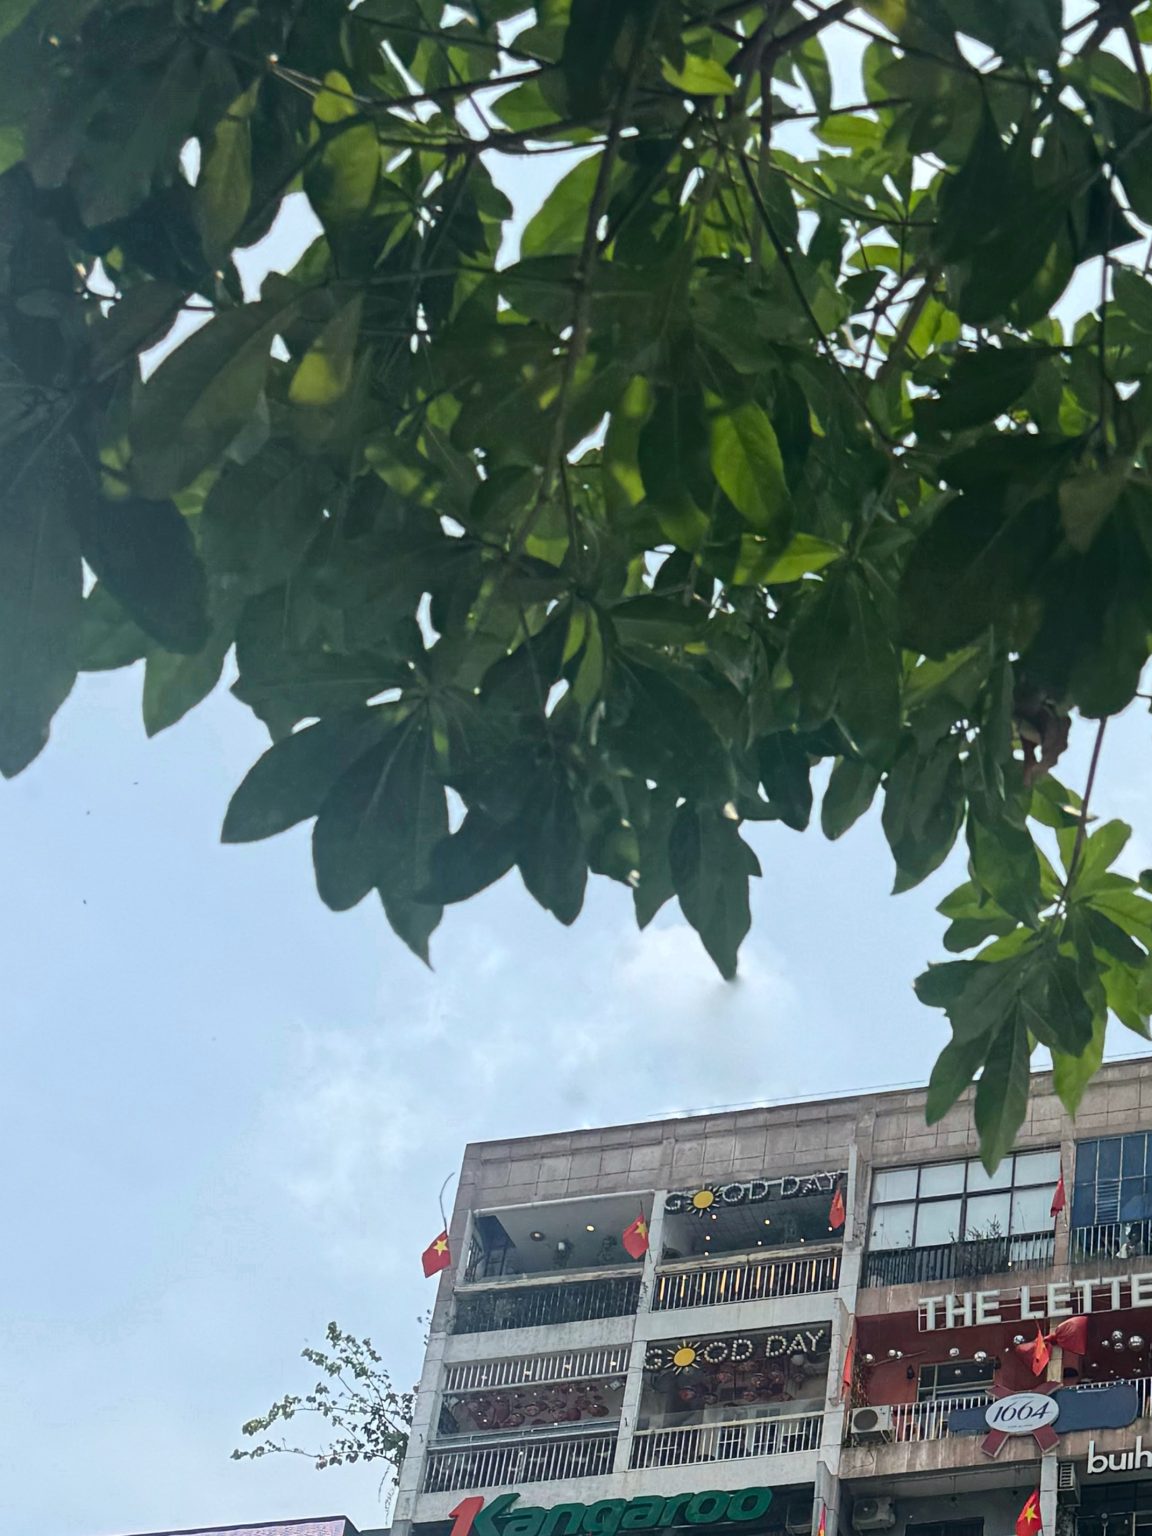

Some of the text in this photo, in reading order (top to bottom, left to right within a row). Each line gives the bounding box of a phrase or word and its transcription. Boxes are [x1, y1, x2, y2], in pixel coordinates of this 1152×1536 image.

[918, 1289, 1002, 1332] THE
[765, 1328, 825, 1359] DAY
[993, 1400, 1053, 1423] 1664
